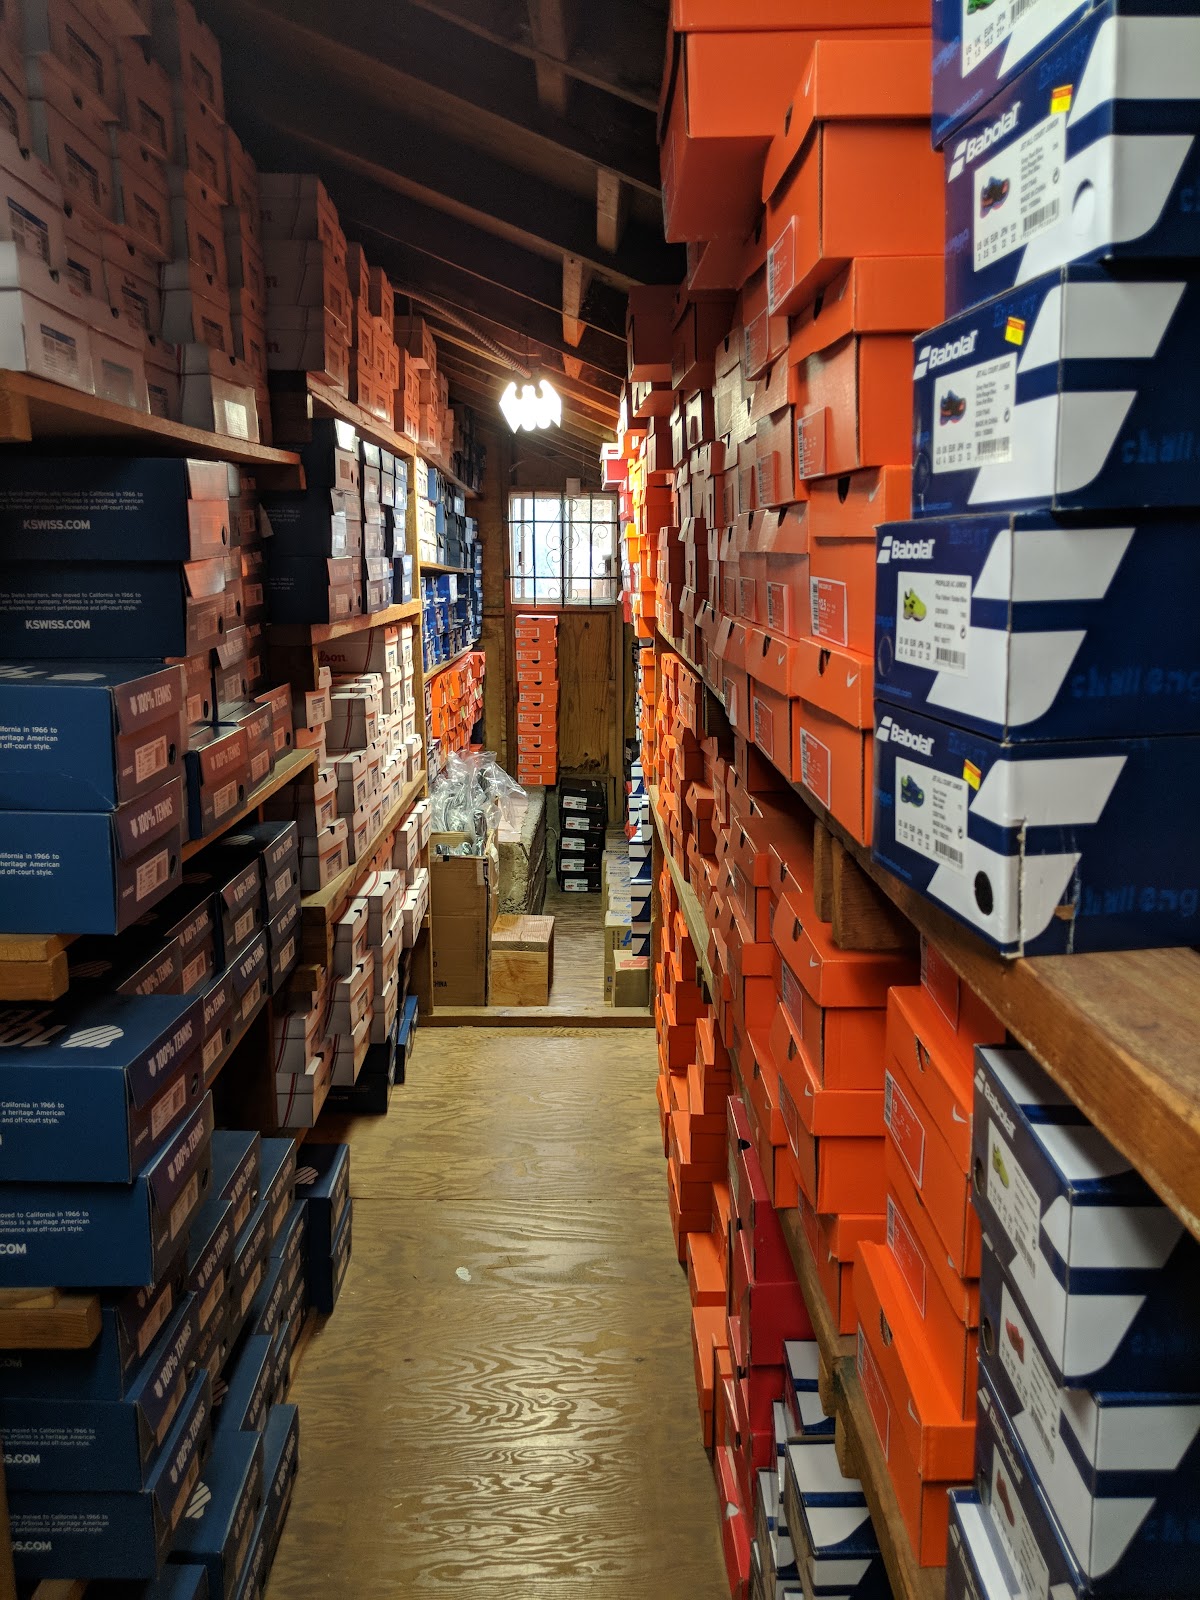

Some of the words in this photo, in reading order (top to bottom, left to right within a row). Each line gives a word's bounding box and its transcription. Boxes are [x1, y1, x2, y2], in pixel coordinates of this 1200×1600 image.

[23, 520, 91, 530] KSWISS.COM
[26, 620, 91, 630] KSWISS.COM
[318, 650, 346, 662] lson
[137, 690, 154, 714] 100%
[154, 684, 171, 707] TENNIS
[138, 808, 156, 834] 100%
[154, 797, 173, 825] TENNIS
[156, 1040, 174, 1071] 100%
[173, 1020, 192, 1052] TENNIS
[174, 1144, 190, 1174] 100%
[188, 1118, 204, 1156] TENNIS
[161, 1352, 178, 1388] 100%
[175, 1320, 192, 1359] TENNIS
